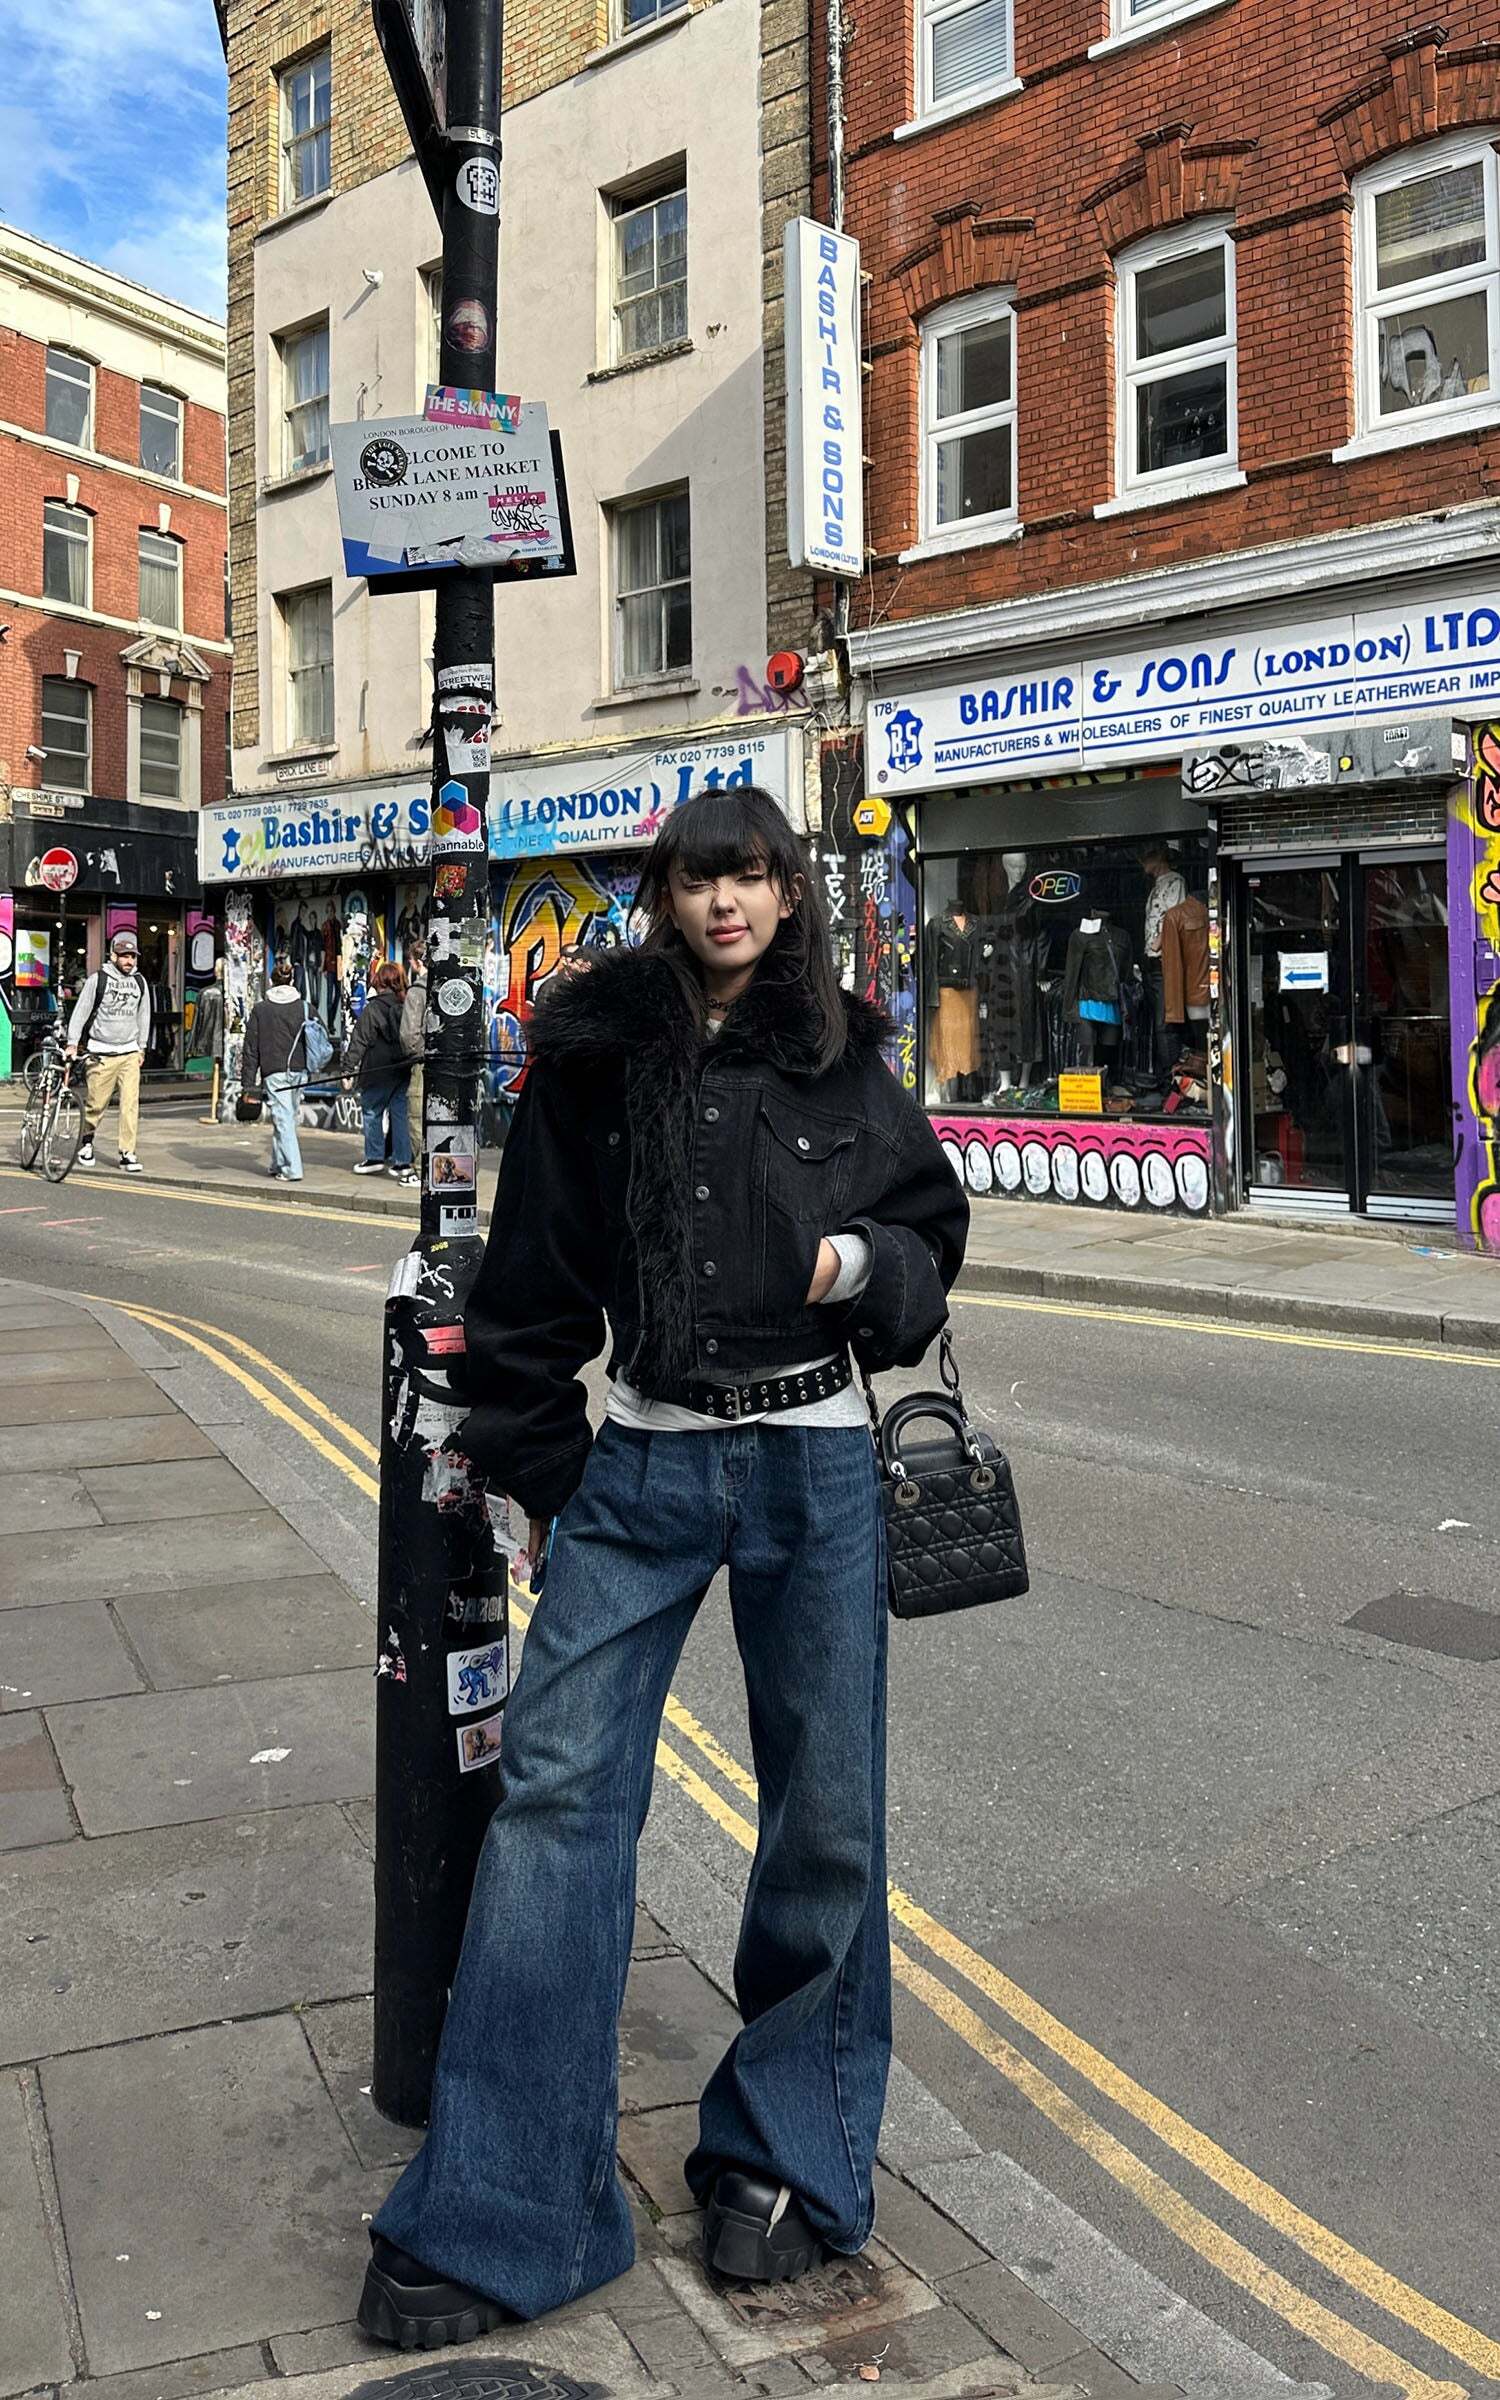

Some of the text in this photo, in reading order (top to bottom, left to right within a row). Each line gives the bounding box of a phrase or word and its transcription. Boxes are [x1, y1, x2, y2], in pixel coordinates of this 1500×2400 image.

[817, 234, 844, 547] BASHIR & SONS
[428, 394, 457, 413] THE
[457, 398, 517, 420] SKINNY
[364, 429, 397, 440] LONDON
[399, 425, 438, 436] BOROUGH
[404, 445, 477, 466] ELCOME
[480, 442, 505, 458] TO
[353, 459, 541, 491] BRK LANE MARKET
[369, 490, 438, 511] SUNDAY
[442, 489, 452, 502] 8
[456, 489, 478, 501] am
[494, 484, 499, 496] 1
[810, 545, 841, 561] LONDON
[960, 676, 1074, 726] BASHIR
[1093, 669, 1122, 703] &
[1136, 648, 1236, 698] SONS
[1255, 624, 1411, 686] (LONDON)
[874, 702, 892, 717] 178
[934, 736, 1040, 764] MANUFACTURERS
[1044, 733, 1054, 746] &
[1059, 718, 1162, 744] WHOLESALERS
[1170, 713, 1190, 729] OF
[1199, 704, 1253, 726] FINEST
[1259, 692, 1327, 717] QUALITY
[1334, 676, 1461, 706] LEATHERWEAR
[655, 740, 765, 766] FAX 020 7739 8115
[299, 760, 317, 775] LANE
[674, 758, 753, 806] Ltd
[213, 812, 226, 821] TEL
[228, 810, 242, 820] 020
[243, 807, 261, 818] 7739
[261, 808, 361, 850] Bashir
[371, 802, 398, 839] &
[859, 811, 874, 824] ADT
[558, 827, 619, 845] QUALITY
[271, 850, 370, 870] MANUFACTURERS
[1029, 877, 1081, 897] OPEN
